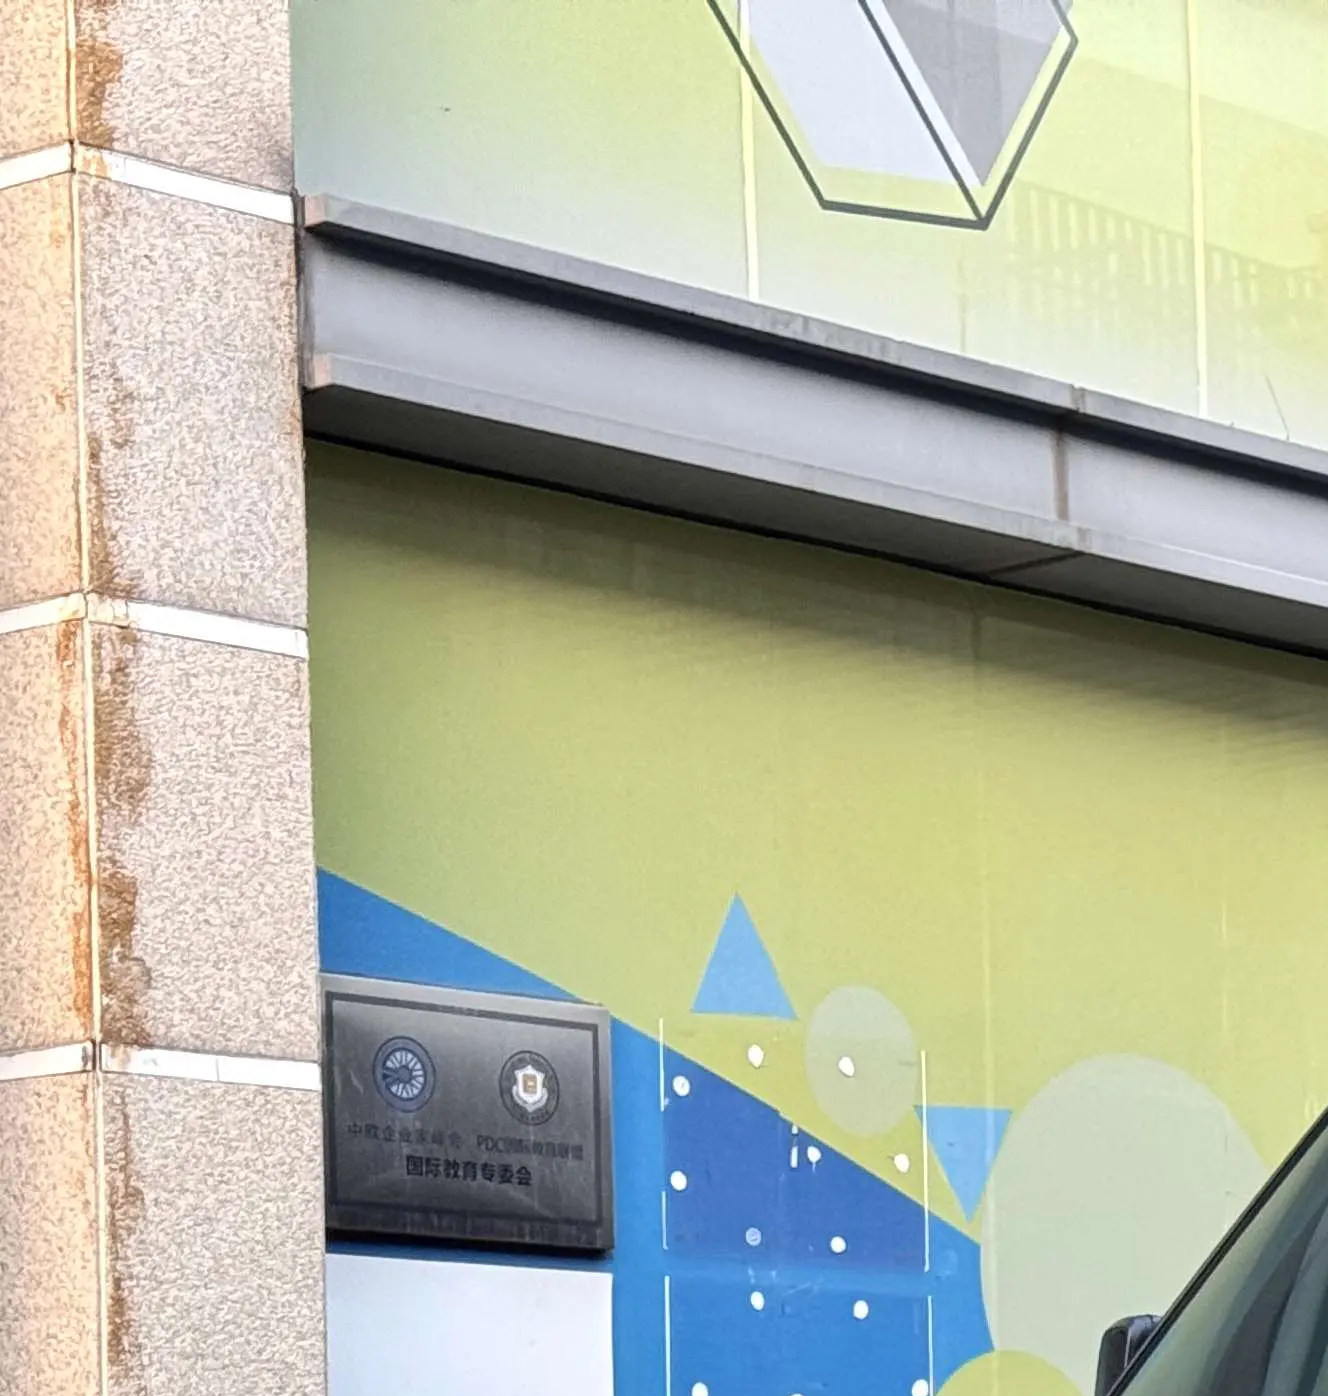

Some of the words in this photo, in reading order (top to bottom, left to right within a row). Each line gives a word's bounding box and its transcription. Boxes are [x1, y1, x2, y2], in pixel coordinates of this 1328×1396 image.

[406, 1155, 532, 1186] 国际教育专委会
